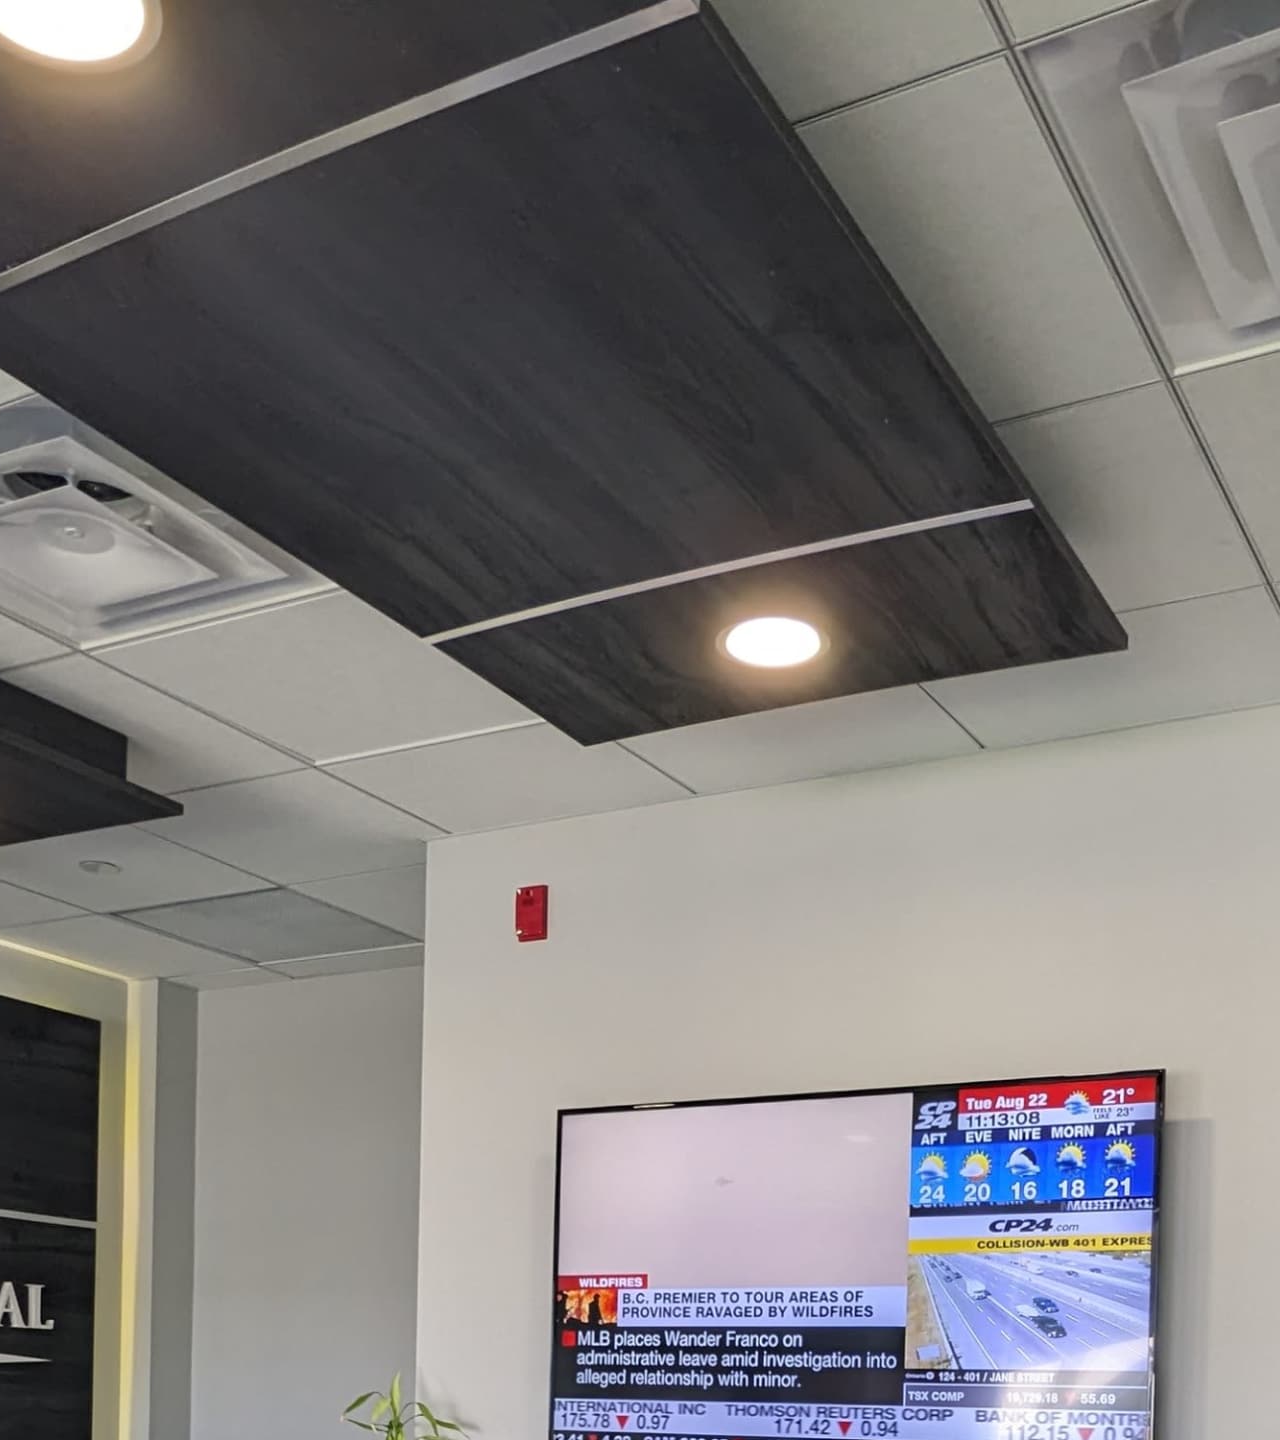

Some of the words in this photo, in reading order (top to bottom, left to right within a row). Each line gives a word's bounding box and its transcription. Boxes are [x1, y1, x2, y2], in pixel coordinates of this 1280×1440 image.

[966, 1098, 992, 1110] Tue
[995, 1096, 1024, 1110] Aug
[1029, 1094, 1047, 1106] 22
[1102, 1088, 1135, 1104] 21°
[920, 1102, 956, 1114] CP
[1117, 1107, 1134, 1117] 23°
[914, 1115, 951, 1130] 24
[966, 1112, 1040, 1127] 11:13:08
[921, 1133, 946, 1145] AFT
[965, 1131, 992, 1142] EVE
[1009, 1128, 1041, 1141] NITE
[1051, 1125, 1094, 1138] MORN
[1106, 1123, 1135, 1136] AFT
[920, 1186, 945, 1202] 24
[964, 1184, 990, 1201] 20
[1011, 1182, 1036, 1199] 16
[1059, 1180, 1085, 1197] 18
[1105, 1178, 1131, 1196] 21
[977, 1238, 1069, 1249] COLLISION-WB
[1074, 1239, 1096, 1247] 401
[579, 1277, 643, 1288] WILDFIRES
[623, 1293, 648, 1305] B.C.
[654, 1293, 716, 1304] PREMIER
[722, 1292, 739, 1303] TO
[744, 1292, 784, 1303] TOUR
[789, 1291, 838, 1303] AREAS
[844, 1291, 863, 1302] OF
[623, 1306, 691, 1318] PROVINCE
[696, 1306, 763, 1318] RAVAGED
[768, 1306, 787, 1317] BY
[792, 1306, 873, 1317] WILDFIRES
[578, 1331, 610, 1346] MLB
[614, 1331, 660, 1349] places
[664, 1331, 721, 1346] Wander
[726, 1332, 778, 1347] Franco
[783, 1335, 802, 1346] on
[577, 1351, 674, 1367] administrative
[679, 1352, 717, 1367] leave
[721, 1352, 757, 1367] amid
[763, 1352, 861, 1371] investigation
[867, 1352, 896, 1368] into
[576, 1370, 626, 1388] alleged
[630, 1371, 713, 1389] relationship
[718, 1371, 748, 1387] with
[753, 1373, 801, 1388] minor.
[939, 1373, 954, 1381] 124
[964, 1373, 979, 1382] 401
[990, 1373, 1014, 1382] JANE
[1017, 1373, 1054, 1383] STREET
[908, 1392, 928, 1400] TSX
[932, 1392, 964, 1401] COMP
[1080, 1393, 1116, 1404] 55.69
[679, 1403, 706, 1415] INC
[726, 1404, 809, 1417] THOMSON
[816, 1407, 896, 1420] REUTERS
[902, 1409, 953, 1421] CORP
[975, 1410, 1028, 1423] BANK
[1035, 1412, 1061, 1424] OF
[562, 1415, 609, 1428] 175.78
[636, 1416, 669, 1430] 0.97
[775, 1419, 830, 1435] 171.42
[861, 1421, 898, 1437] 0.94
[1006, 1426, 1069, 1440] 112.15
